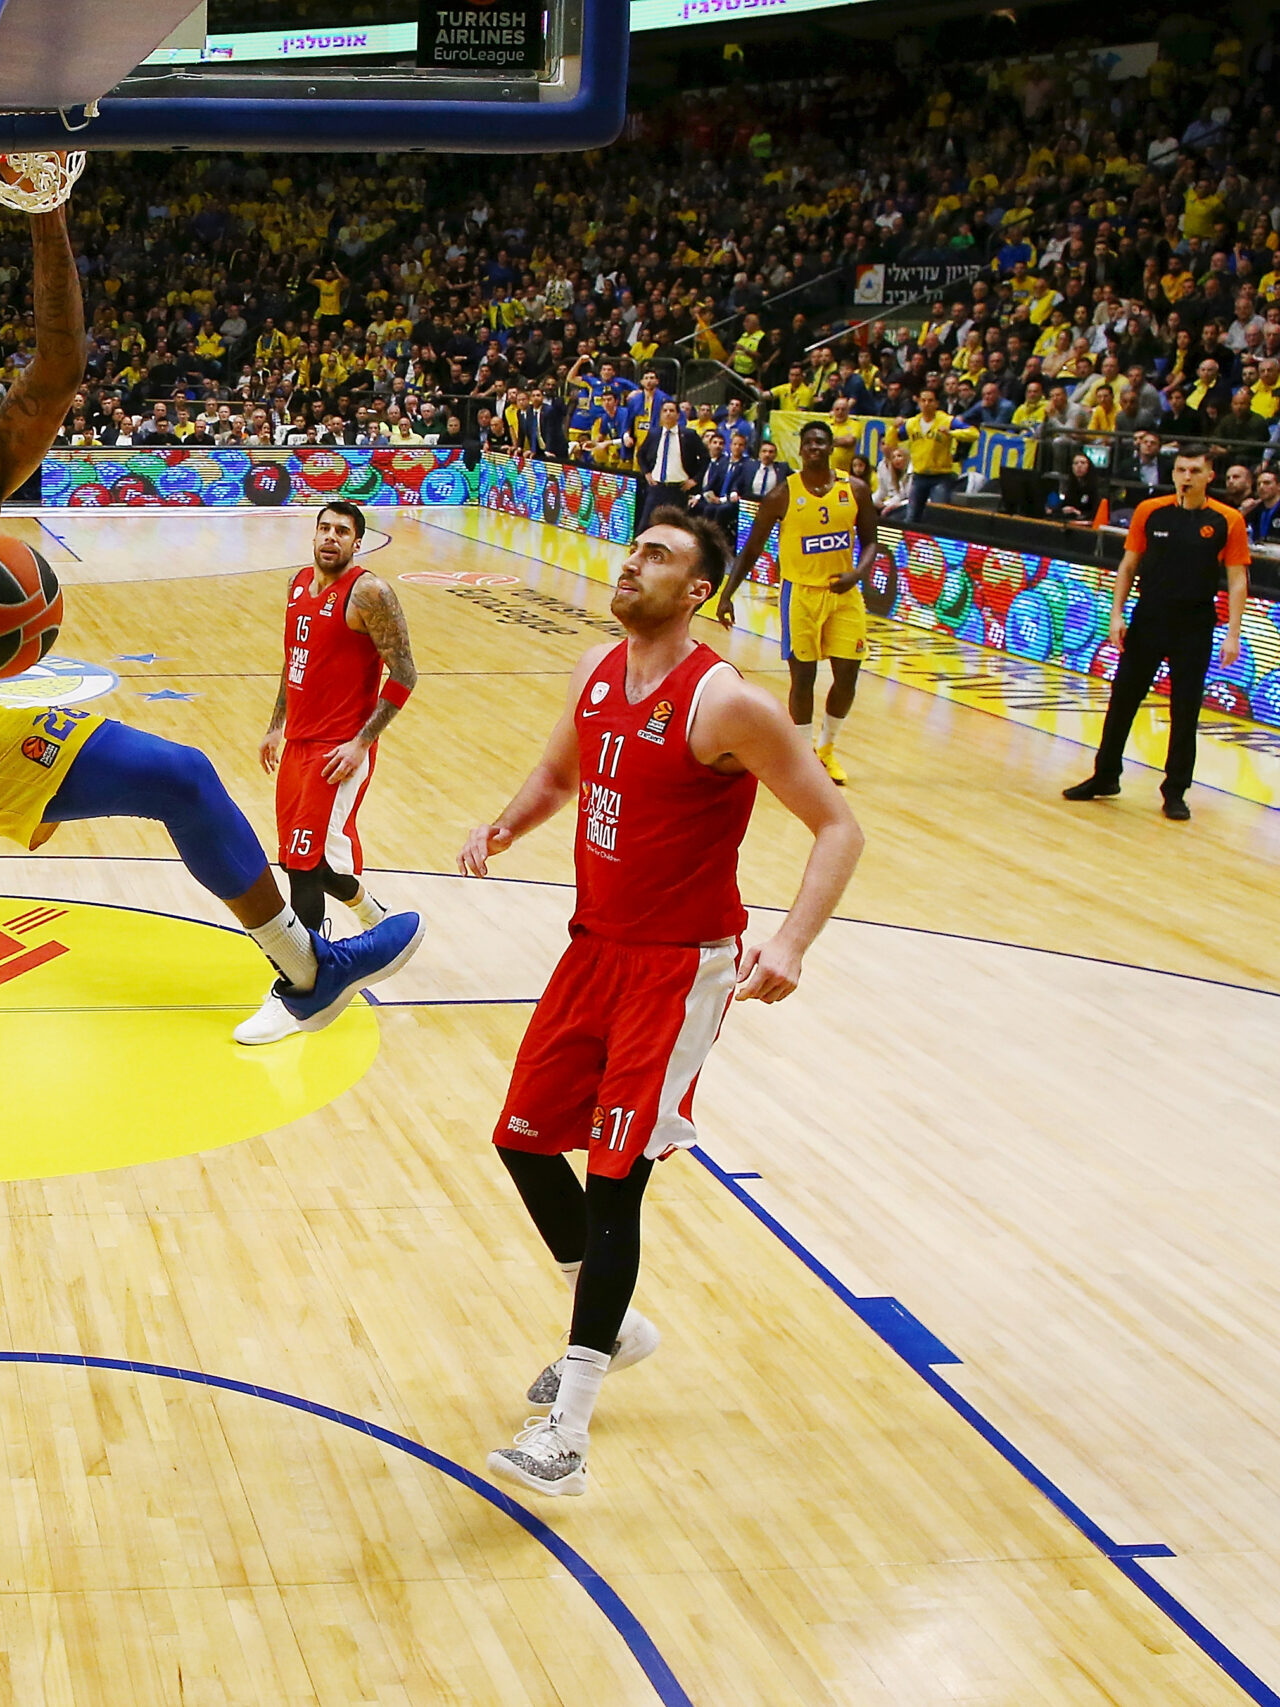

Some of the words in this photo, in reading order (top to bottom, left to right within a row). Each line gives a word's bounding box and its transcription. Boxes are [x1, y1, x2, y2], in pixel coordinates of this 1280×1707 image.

[436, 11, 526, 27] TURKISH
[435, 29, 526, 45] AIRLINES
[434, 47, 525, 65] EuroLeague
[818, 506, 829, 525] 3
[805, 533, 849, 552] FOX
[296, 615, 312, 642] 15
[597, 731, 626, 778] 11
[289, 828, 313, 855] 15
[507, 1123, 539, 1138] POWER
[510, 1115, 529, 1128] RED
[608, 1107, 636, 1152] 11
